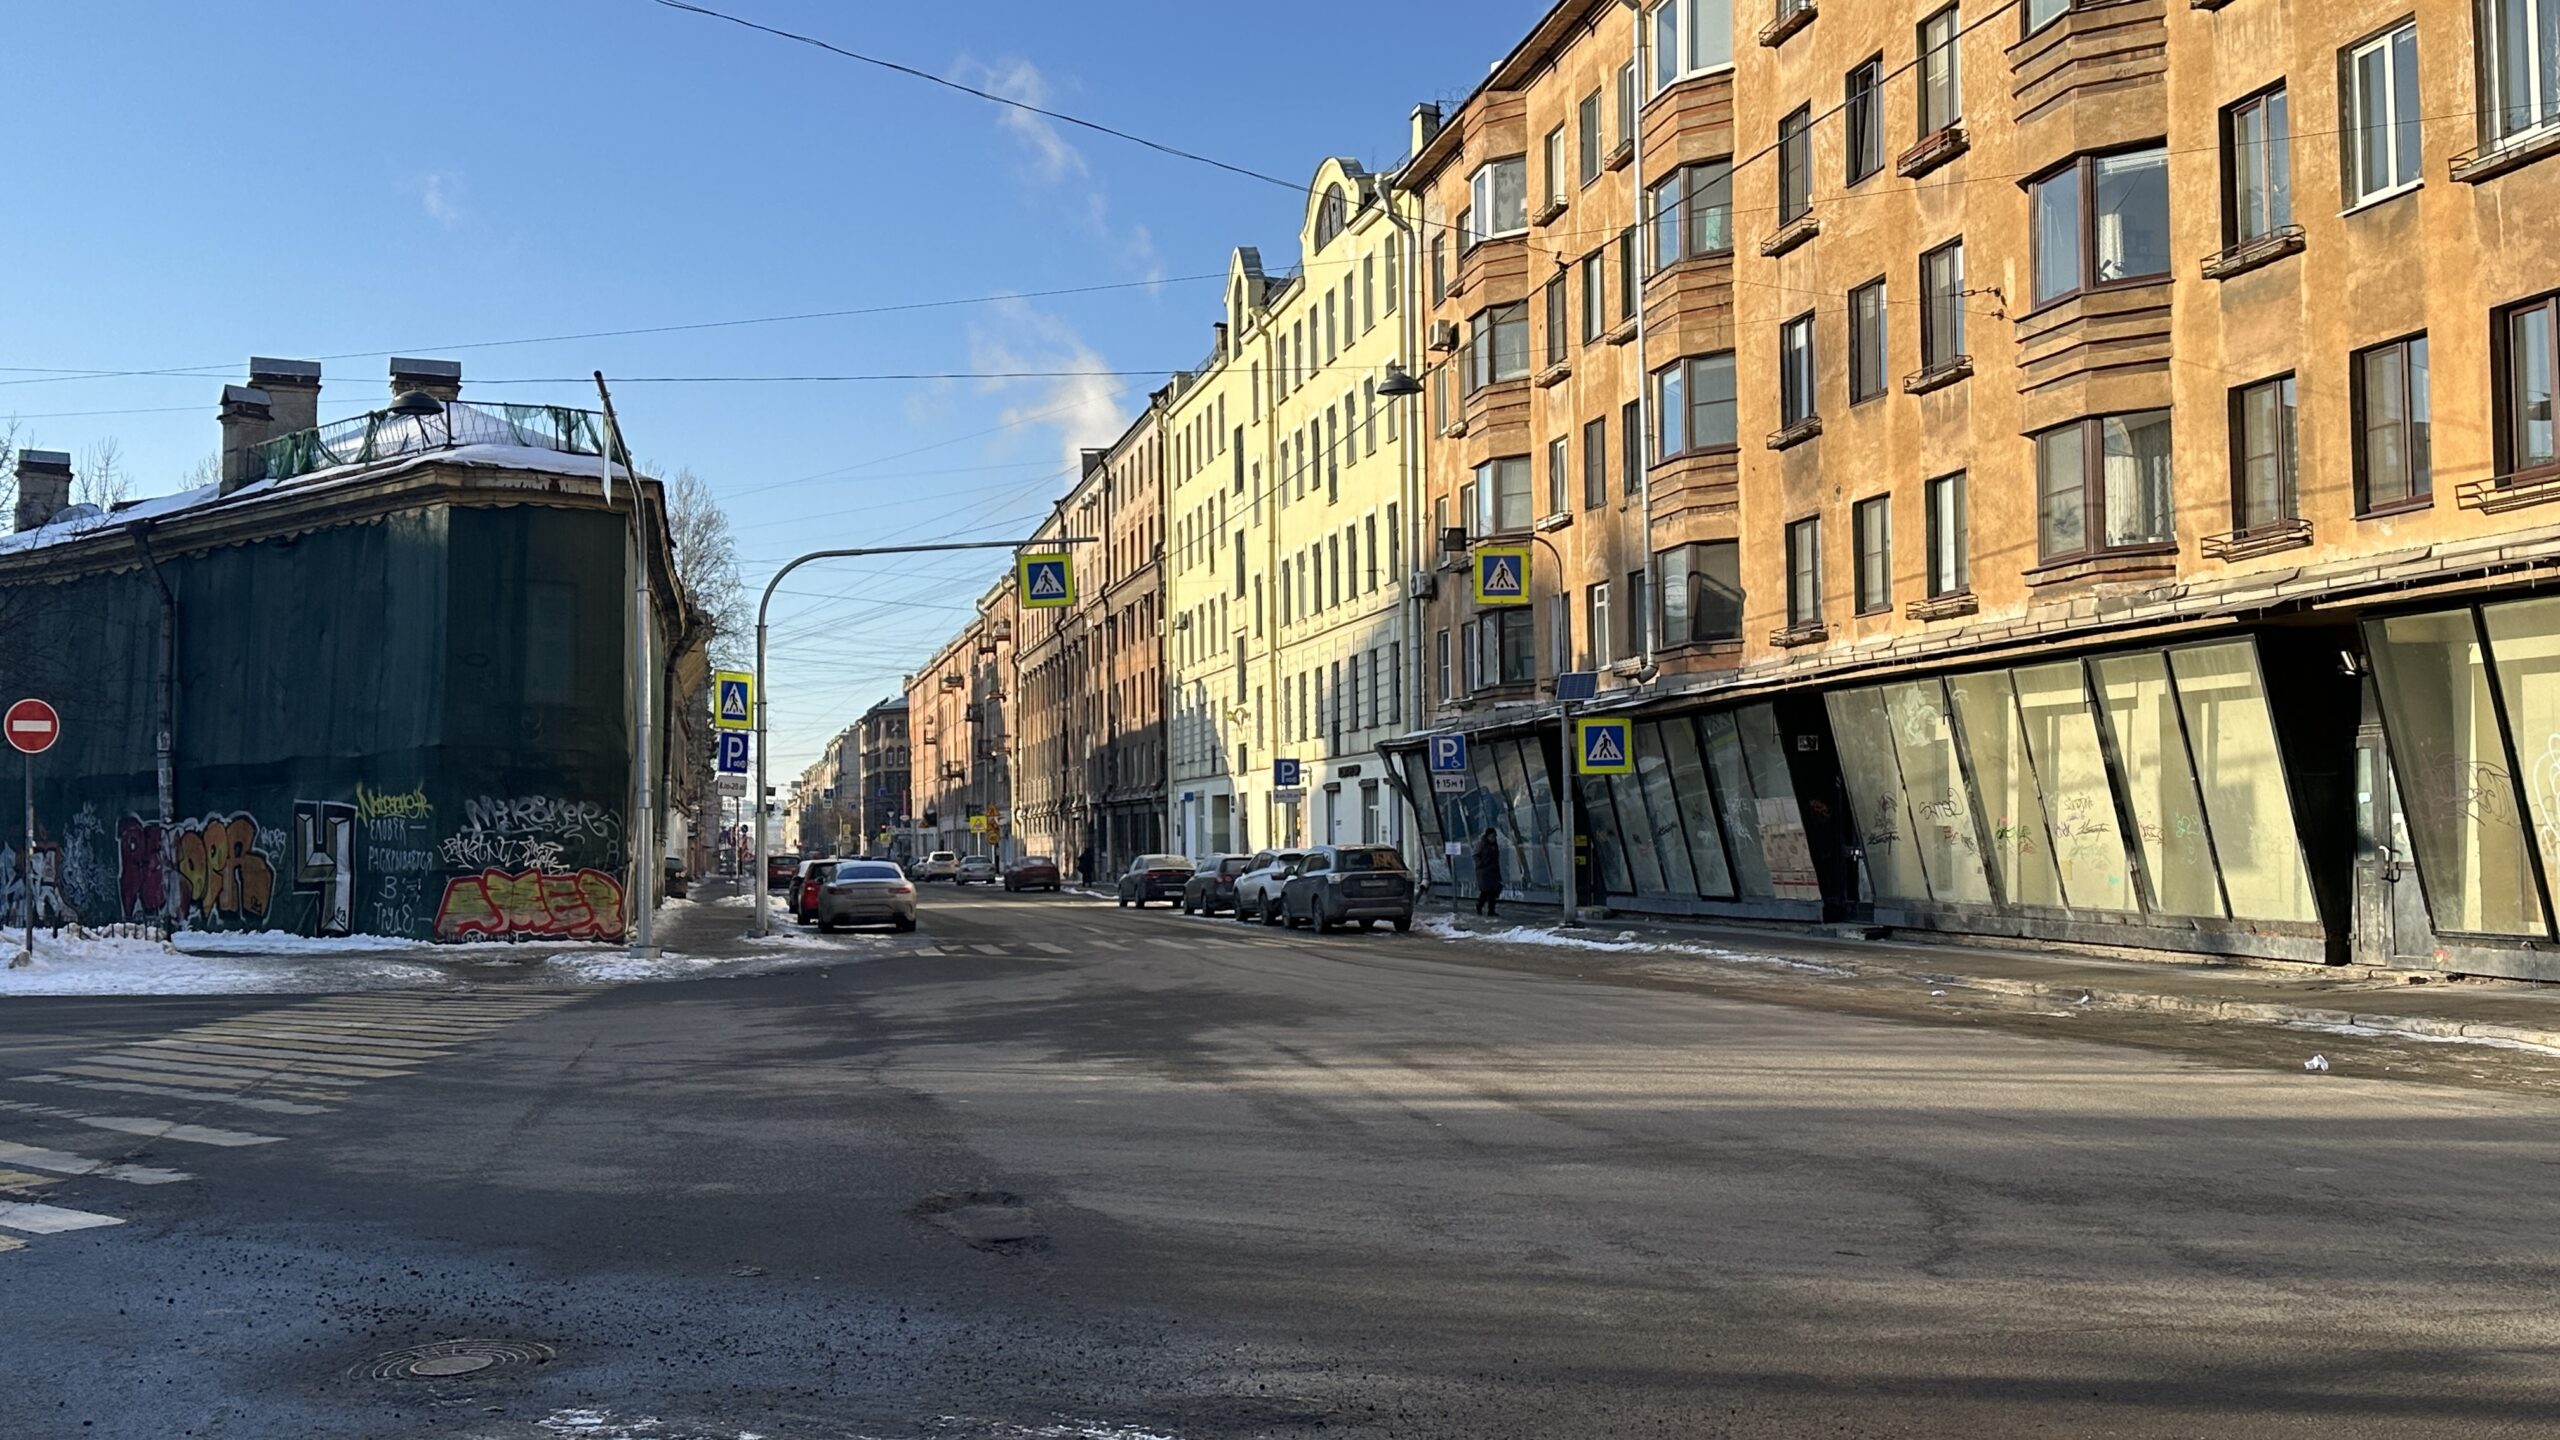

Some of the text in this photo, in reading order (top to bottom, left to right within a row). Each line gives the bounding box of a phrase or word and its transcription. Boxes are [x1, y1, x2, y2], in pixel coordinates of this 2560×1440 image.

[726, 736, 744, 769] P
[1438, 739, 1458, 767] P
[1280, 761, 1296, 784] P
